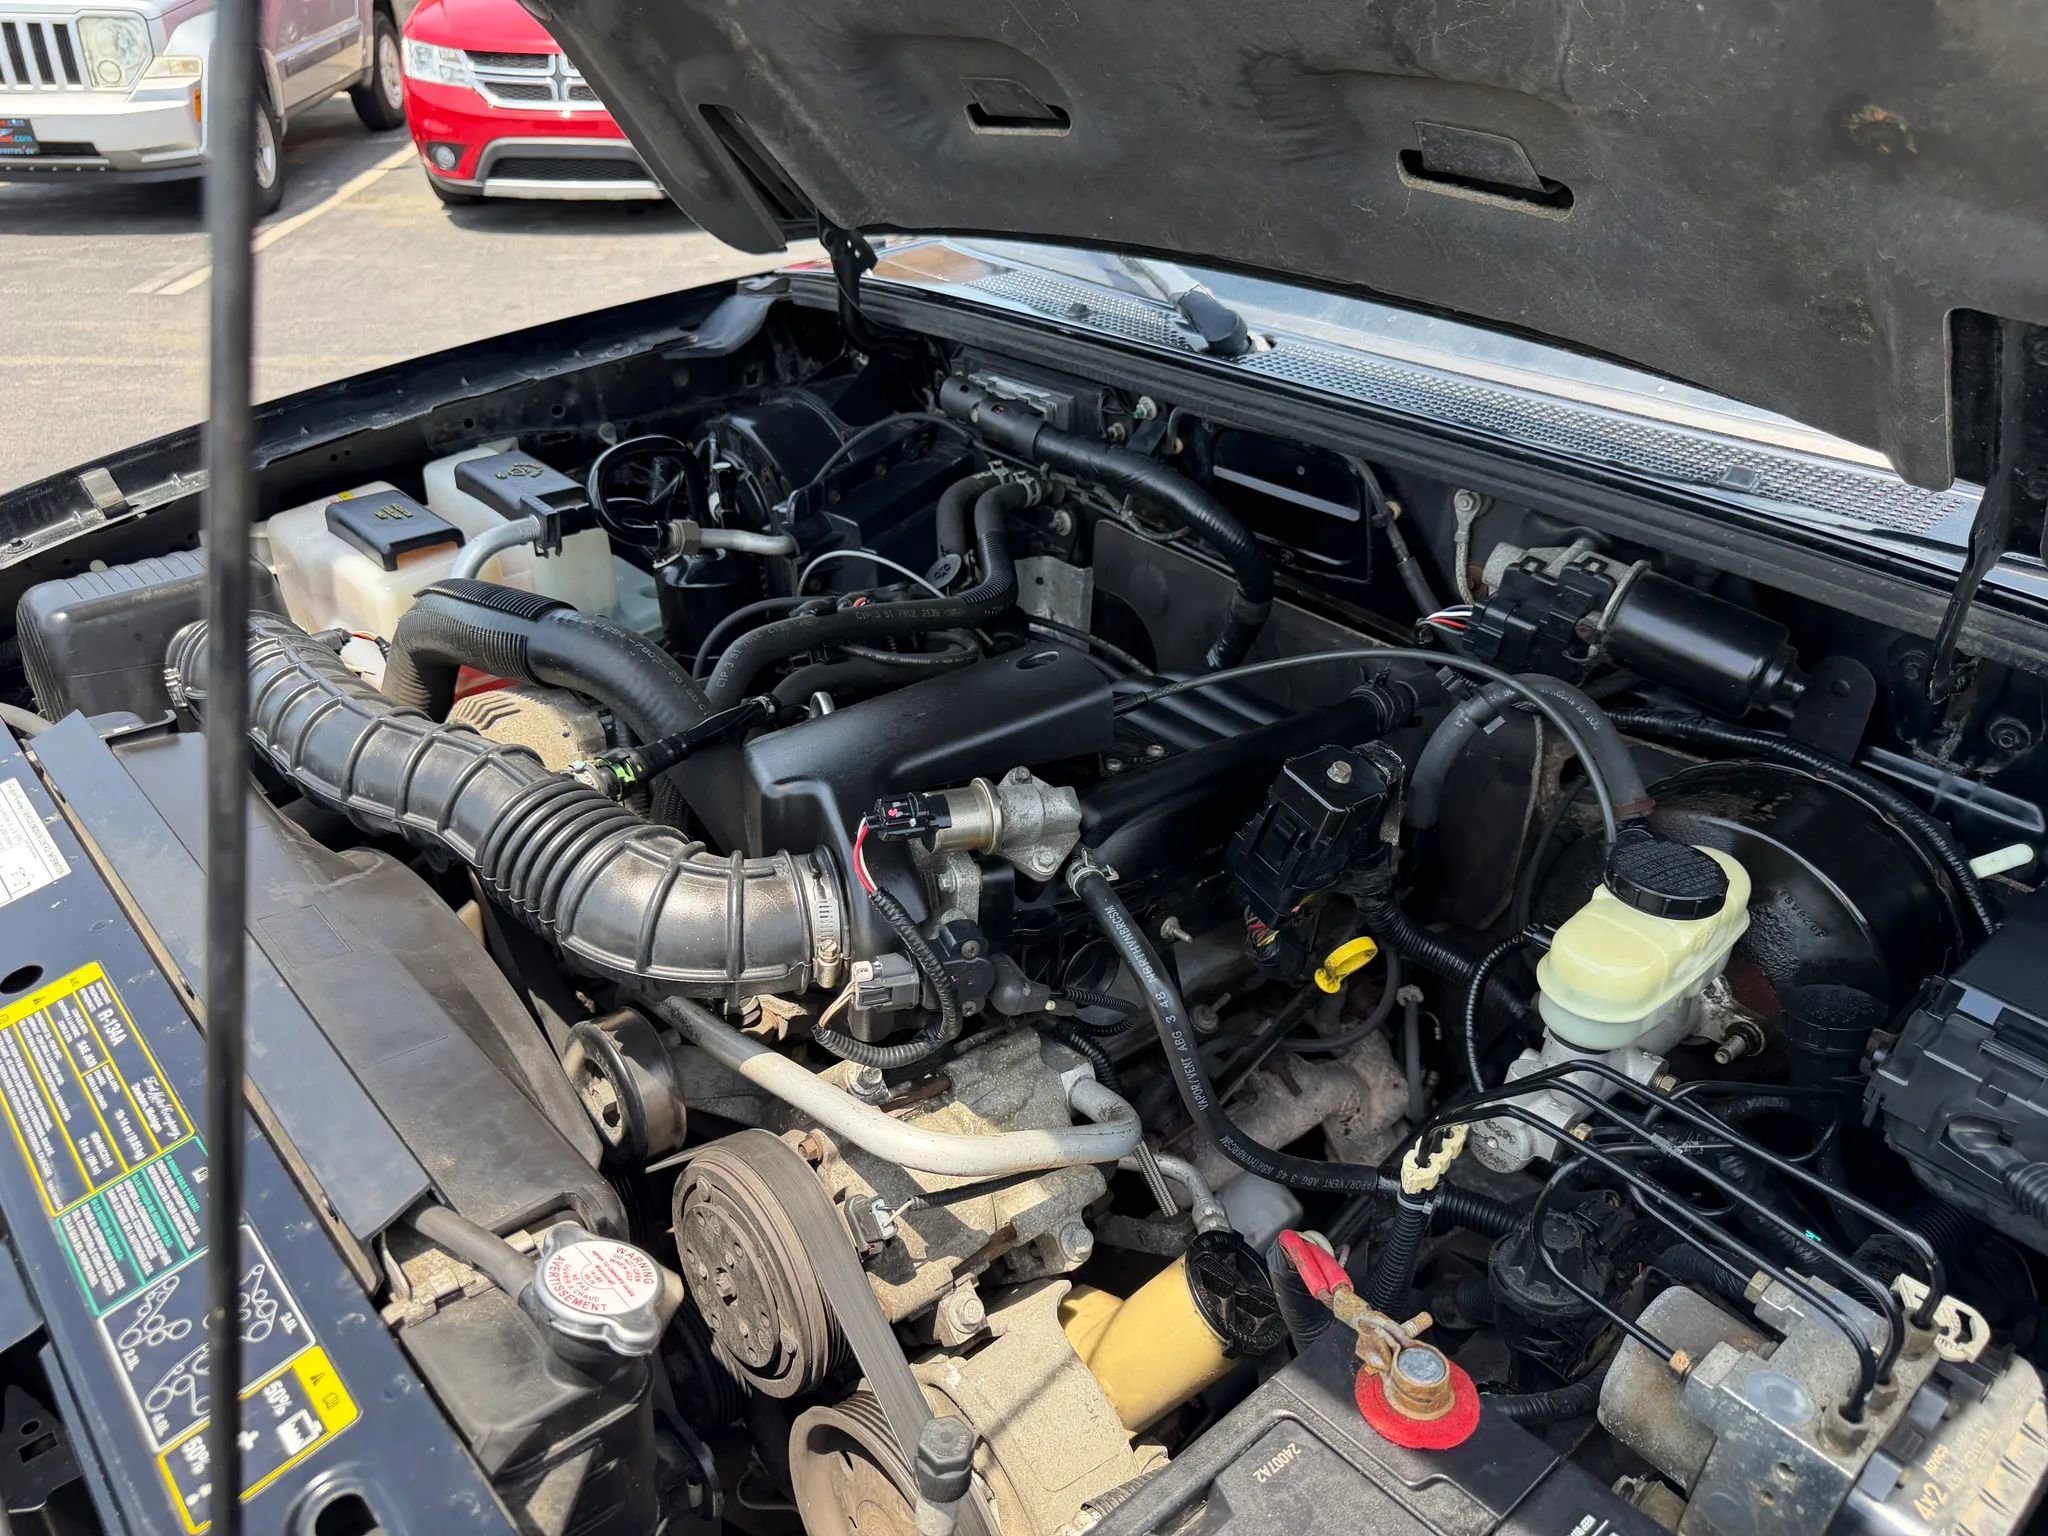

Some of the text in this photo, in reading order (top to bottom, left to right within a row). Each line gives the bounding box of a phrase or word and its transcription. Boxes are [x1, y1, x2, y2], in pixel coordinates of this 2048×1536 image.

[1155, 991, 1169, 1007] 48
[98, 1008, 127, 1046] R-134A
[1165, 1014, 1176, 1023] 3
[1171, 1030, 1188, 1051] ABG
[1180, 1057, 1208, 1110] VAPOR/VENT
[547, 1254, 608, 1312] AVERTISSEMENT
[616, 1246, 654, 1286] WARNING
[573, 1288, 600, 1302] CHAUD
[280, 1312, 297, 1334] 3.0L
[263, 1380, 291, 1416] 50%
[182, 1436, 209, 1474] 50%
[1253, 1443, 1301, 1482] 24007A2
